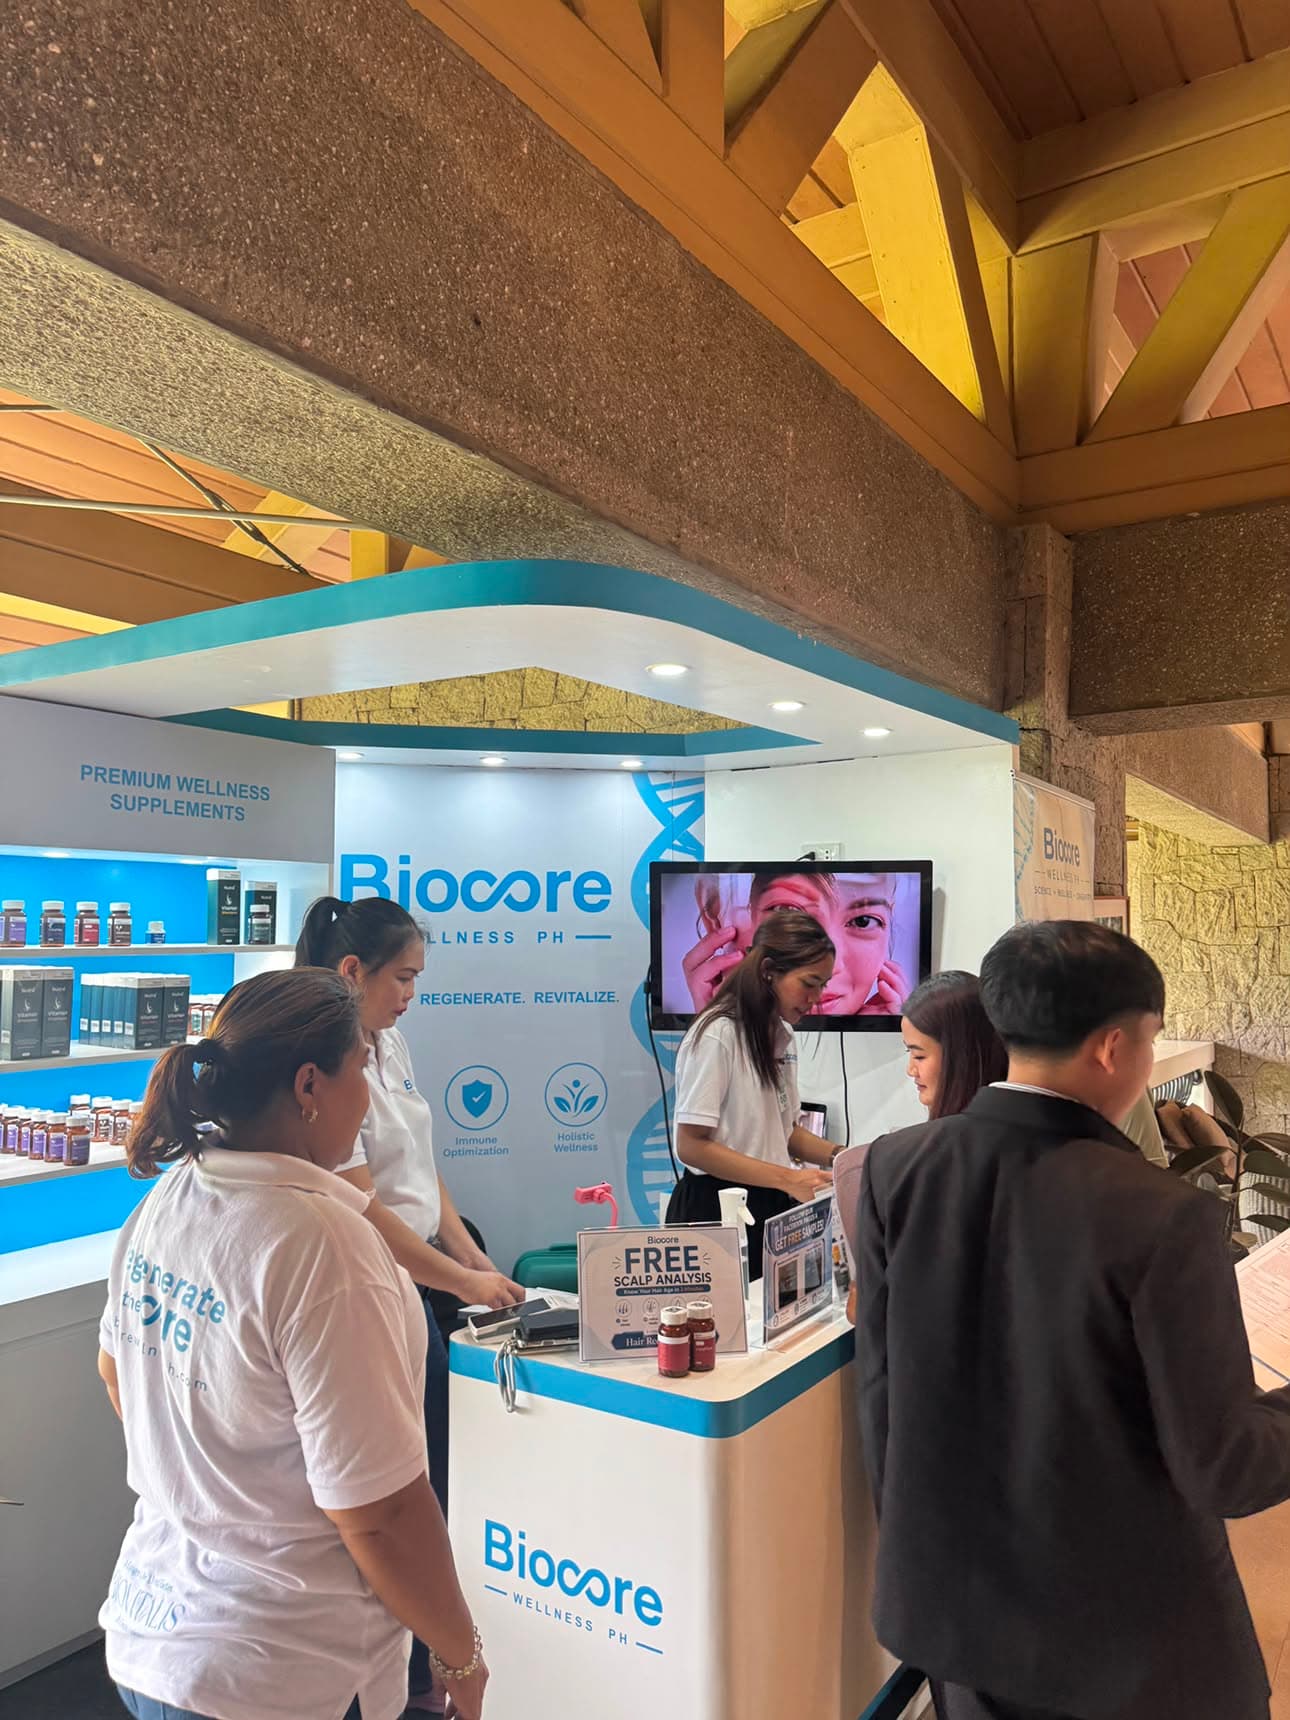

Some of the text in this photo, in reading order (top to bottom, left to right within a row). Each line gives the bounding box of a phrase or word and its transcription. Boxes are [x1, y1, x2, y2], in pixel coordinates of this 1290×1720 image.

[80, 764, 271, 801] PREMIUM WELLNESS
[110, 793, 245, 821] SUPPLEMENTS
[1043, 827, 1080, 867] Biocore
[340, 854, 612, 913] Biocore
[427, 931, 564, 944] LLNESS PH
[420, 990, 620, 1005] REGENERATE. REVITALIZE.
[455, 1135, 498, 1146] Immune
[557, 1132, 595, 1142] Holistic
[443, 1146, 509, 1158] Optimization
[553, 1142, 598, 1153] Wellness
[647, 1235, 679, 1244] Biocore
[625, 1245, 700, 1274] FREE
[614, 1272, 712, 1287] SCALP ANALYSIS
[626, 1336, 645, 1347] Hair
[484, 1518, 664, 1627] Biocore
[512, 1591, 628, 1645] WELLNESS PH
